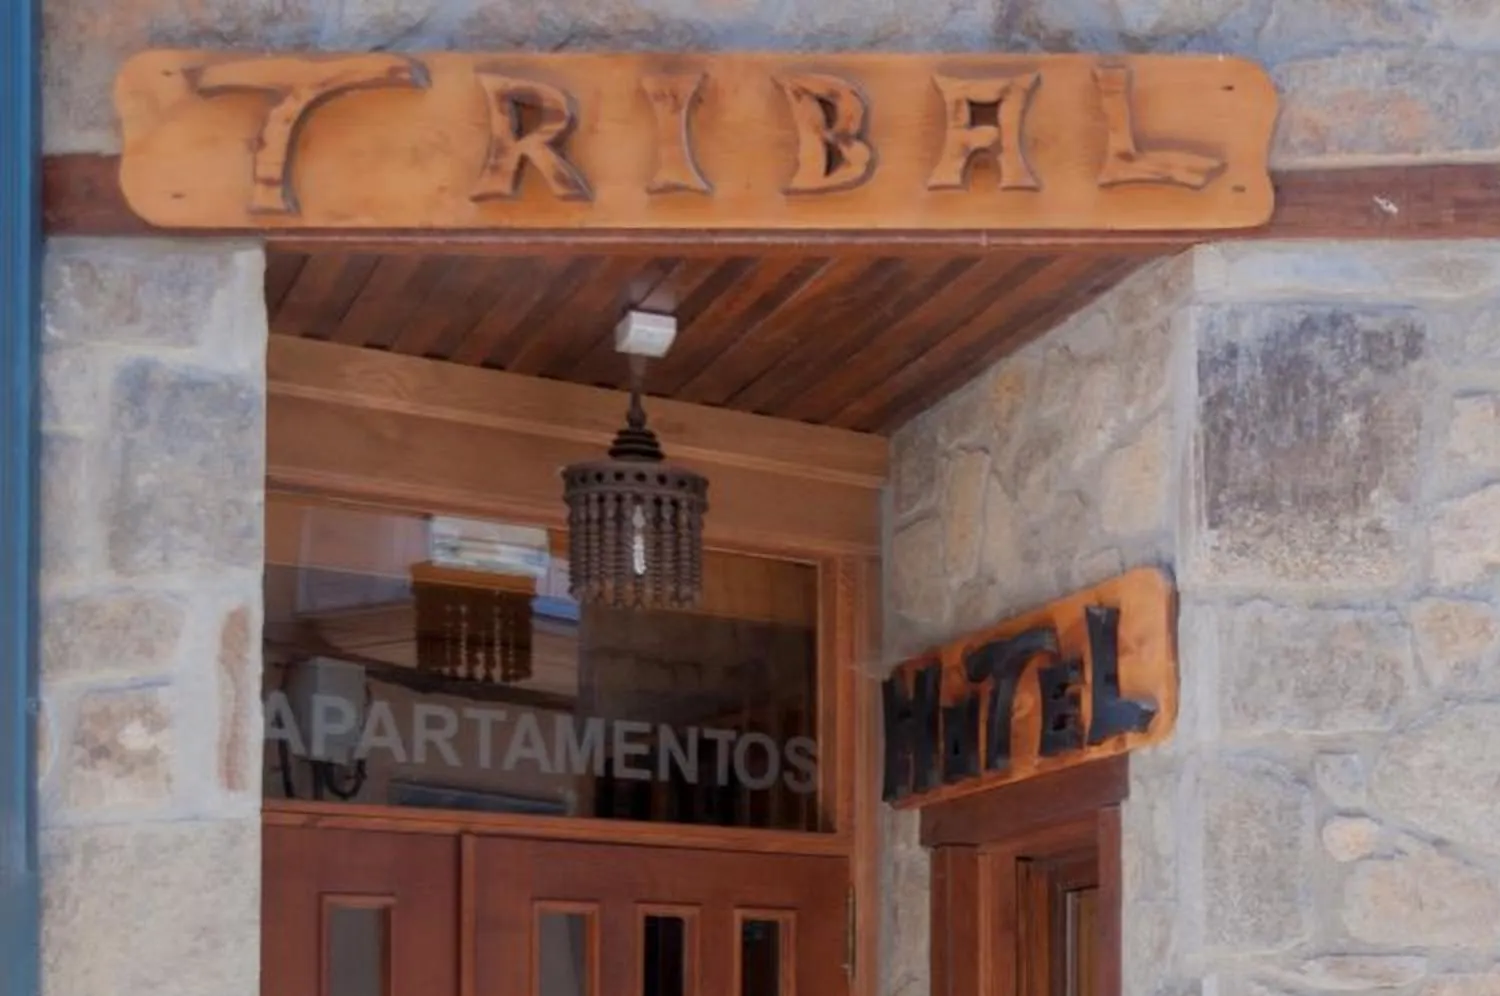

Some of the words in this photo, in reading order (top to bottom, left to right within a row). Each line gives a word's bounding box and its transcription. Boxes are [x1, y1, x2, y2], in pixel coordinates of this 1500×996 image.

[181, 53, 1227, 216] TRIBAL
[263, 689, 819, 794] APARTAMENTOS
[881, 605, 1159, 802] HOTEL
